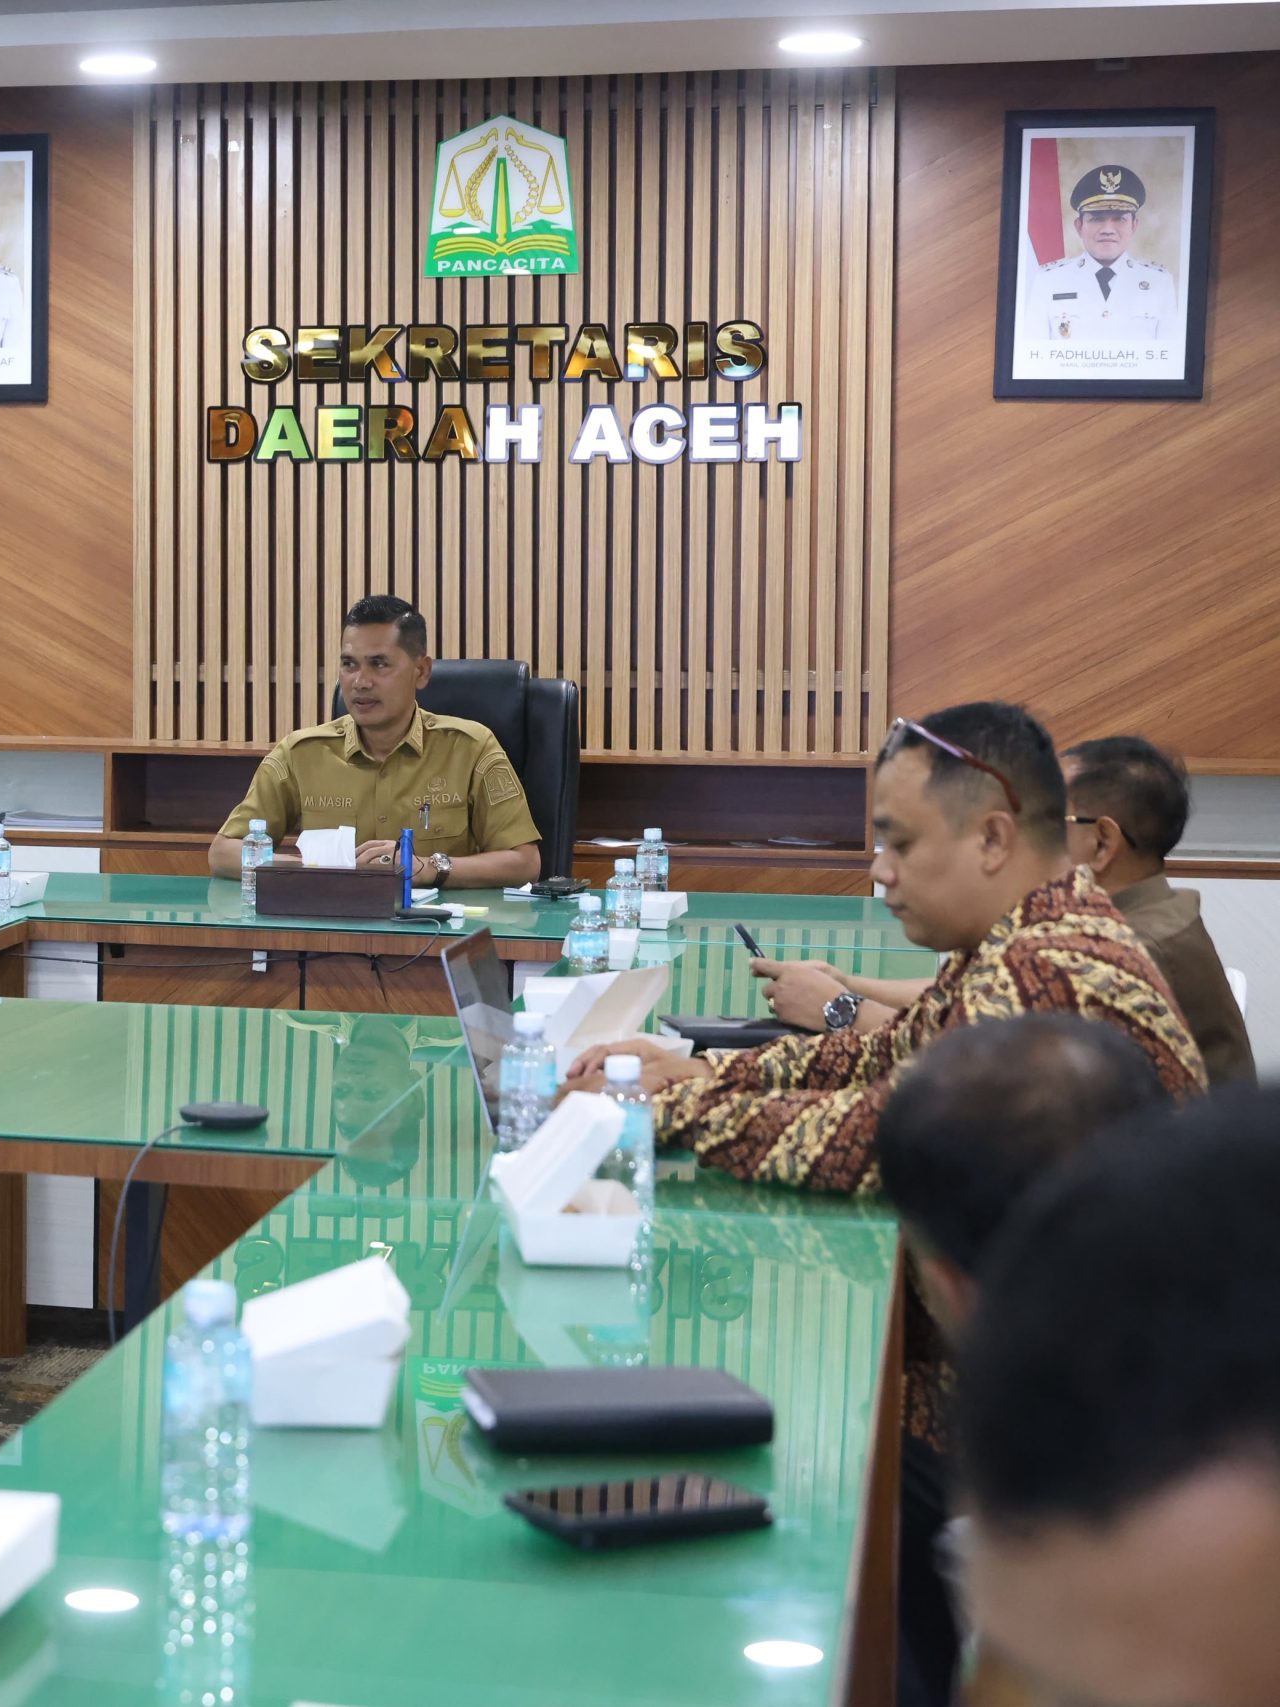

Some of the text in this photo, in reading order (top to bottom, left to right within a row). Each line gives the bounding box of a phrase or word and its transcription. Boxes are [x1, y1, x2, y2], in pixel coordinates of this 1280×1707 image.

[437, 257, 566, 272] PANCACITA
[241, 320, 766, 384] SEKRETARIS
[207, 402, 802, 464] DAERAH ACEH
[319, 796, 353, 808] NASIR
[413, 792, 462, 806] SEKDA
